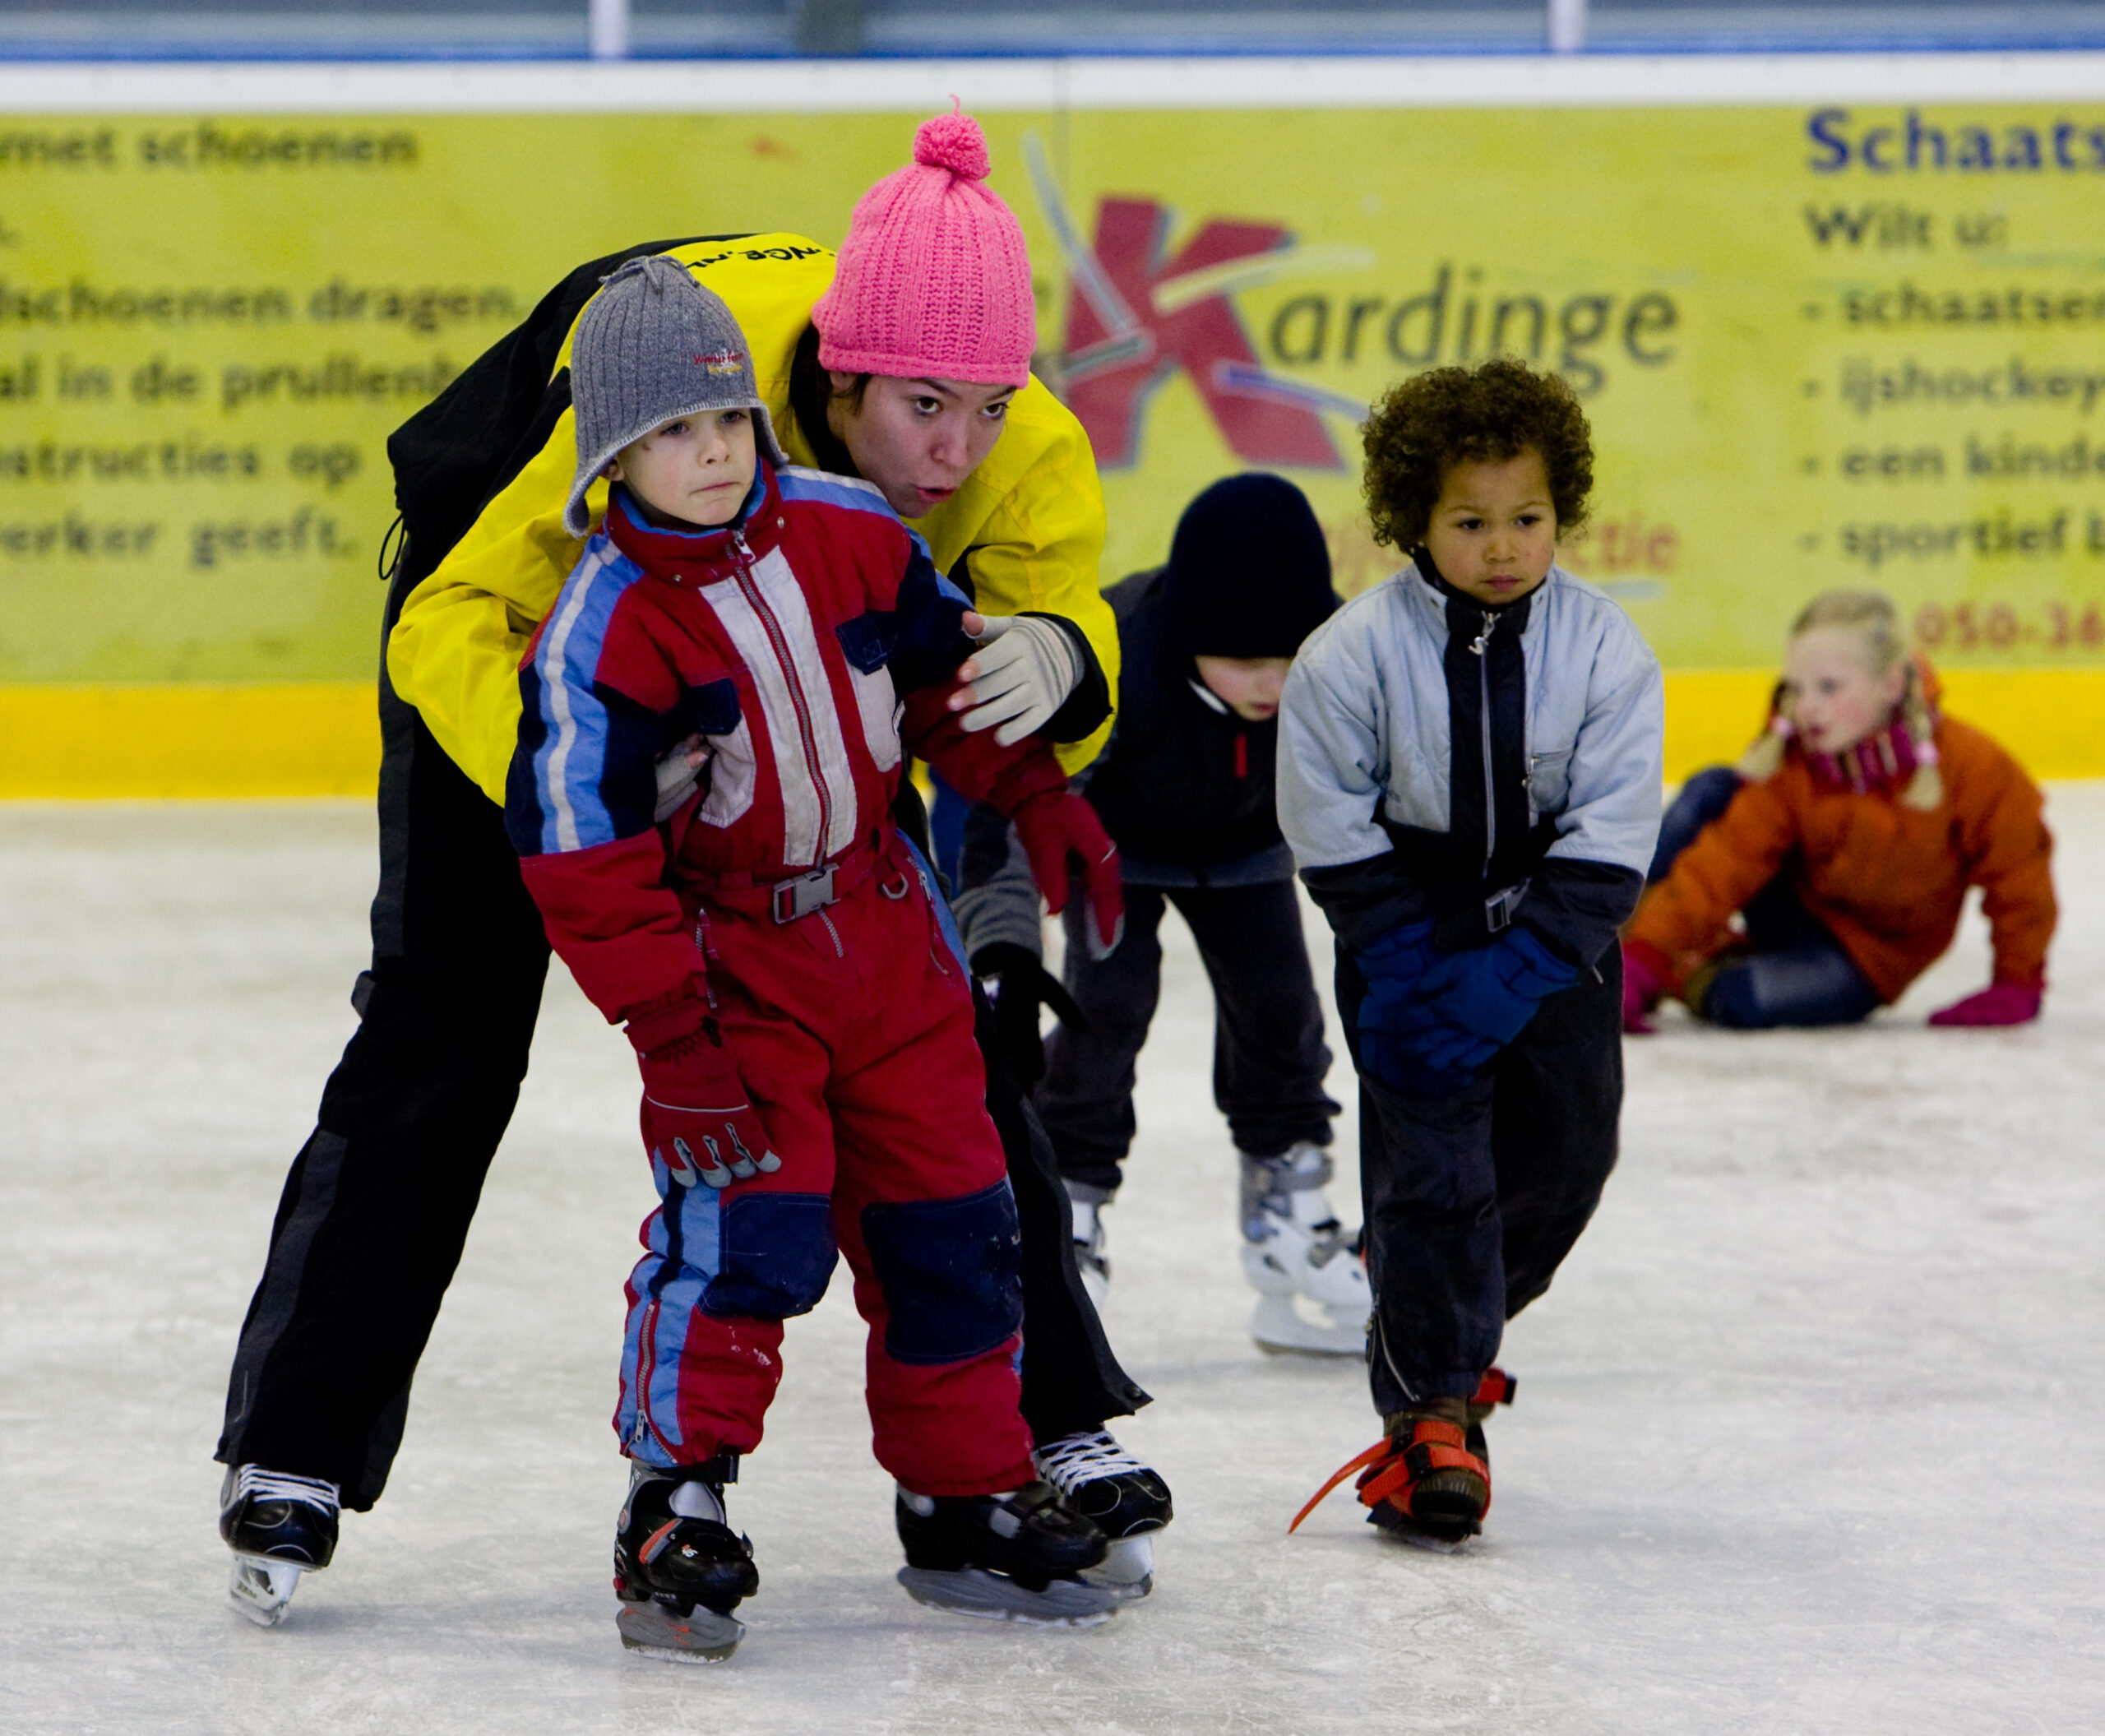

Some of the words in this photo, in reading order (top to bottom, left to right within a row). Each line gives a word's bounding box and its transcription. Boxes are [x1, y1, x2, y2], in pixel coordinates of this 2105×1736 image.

[140, 119, 419, 169] schoenen
[1802, 202, 1932, 250] Wilt
[58, 355, 113, 400] in
[130, 356, 198, 403] de
[285, 442, 362, 493] op
[1842, 445, 1945, 481] een
[0, 508, 158, 559] erker
[1840, 507, 2070, 569] sportief
